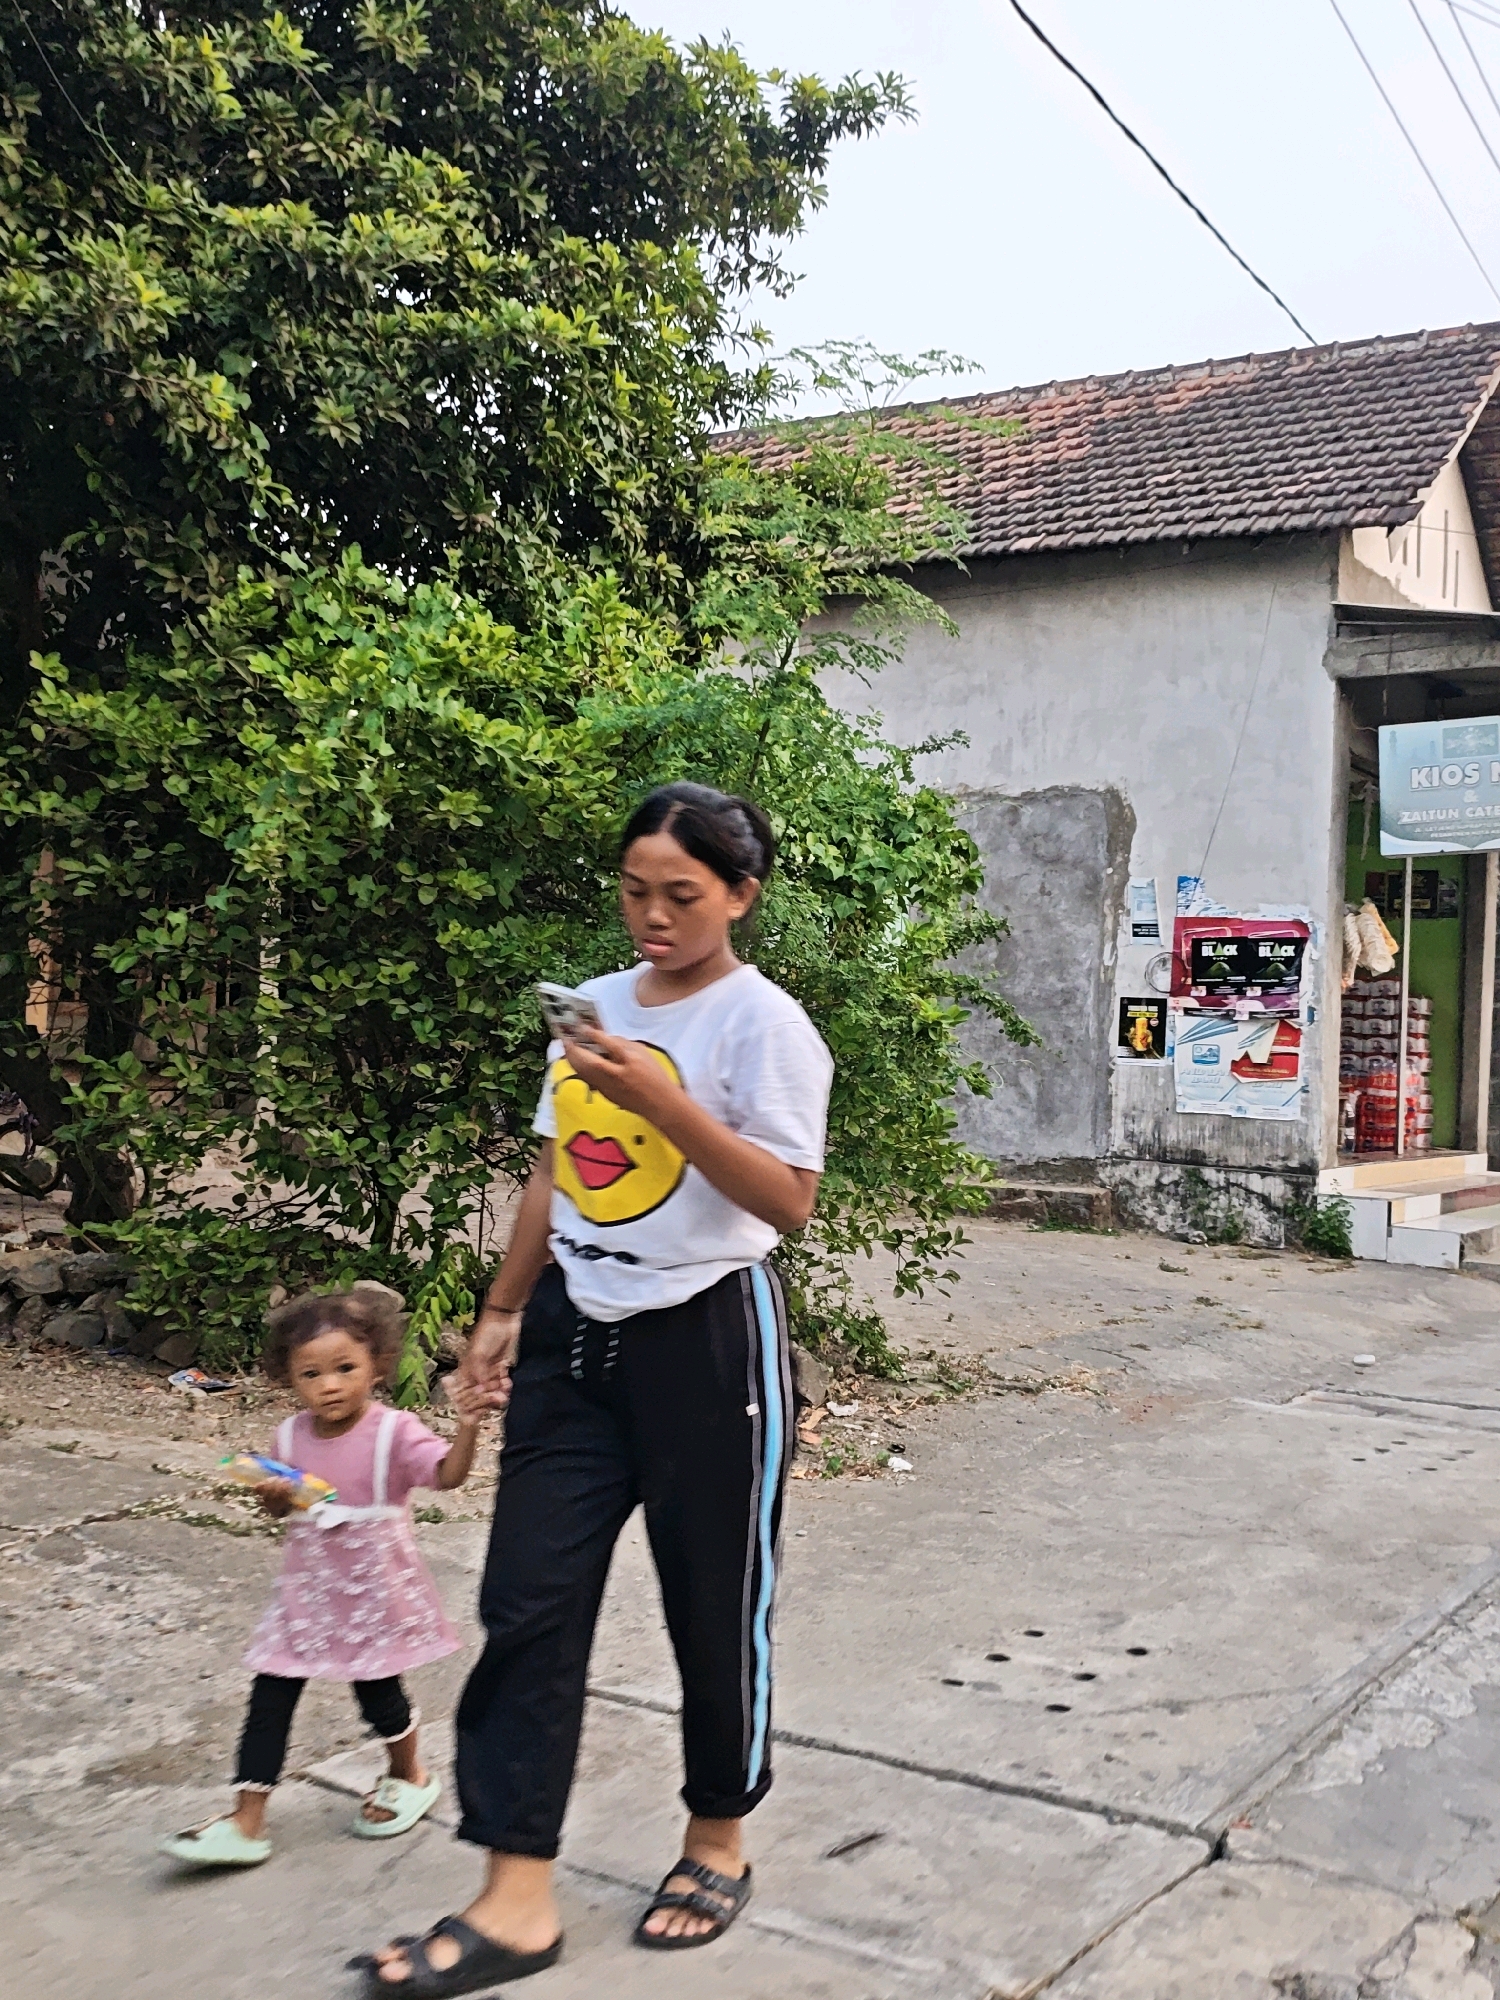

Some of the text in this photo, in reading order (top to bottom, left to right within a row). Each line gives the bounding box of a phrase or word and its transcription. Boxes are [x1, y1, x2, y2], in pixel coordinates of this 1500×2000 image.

[1410, 762, 1480, 790] KIOS
[1464, 790, 1479, 803] &
[1401, 809, 1459, 823] ZAITUN
[1202, 942, 1238, 957] BLACK
[1258, 942, 1296, 957] BLACK
